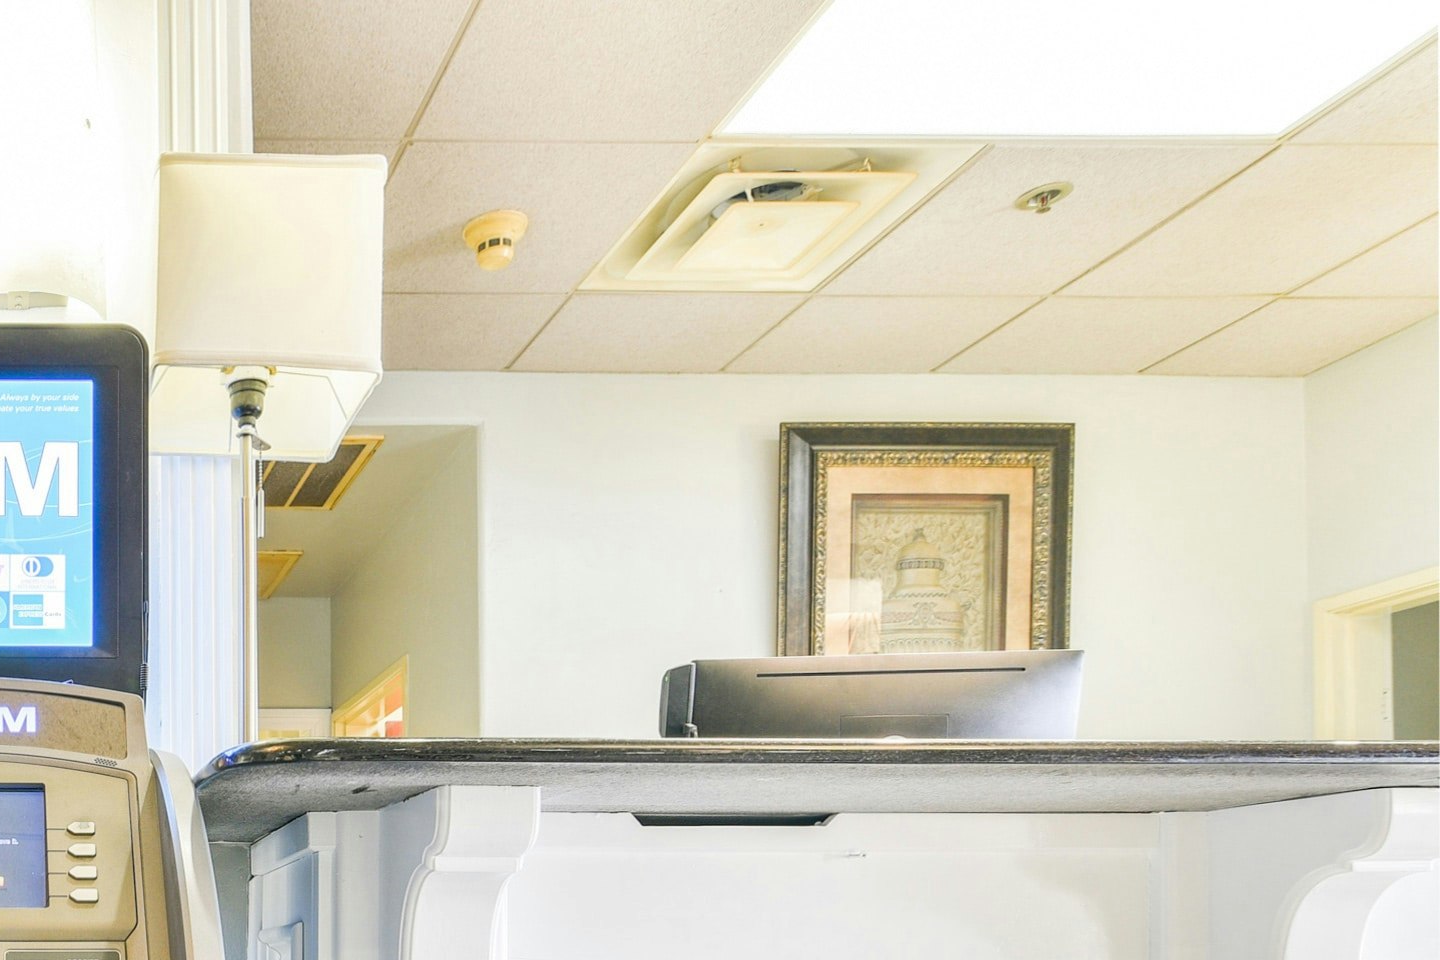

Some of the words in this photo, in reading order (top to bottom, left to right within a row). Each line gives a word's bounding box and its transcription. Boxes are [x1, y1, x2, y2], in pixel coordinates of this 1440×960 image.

[0, 393, 29, 402] Always
[31, 394, 40, 402] by
[62, 393, 80, 401] side
[15, 405, 33, 414] your
